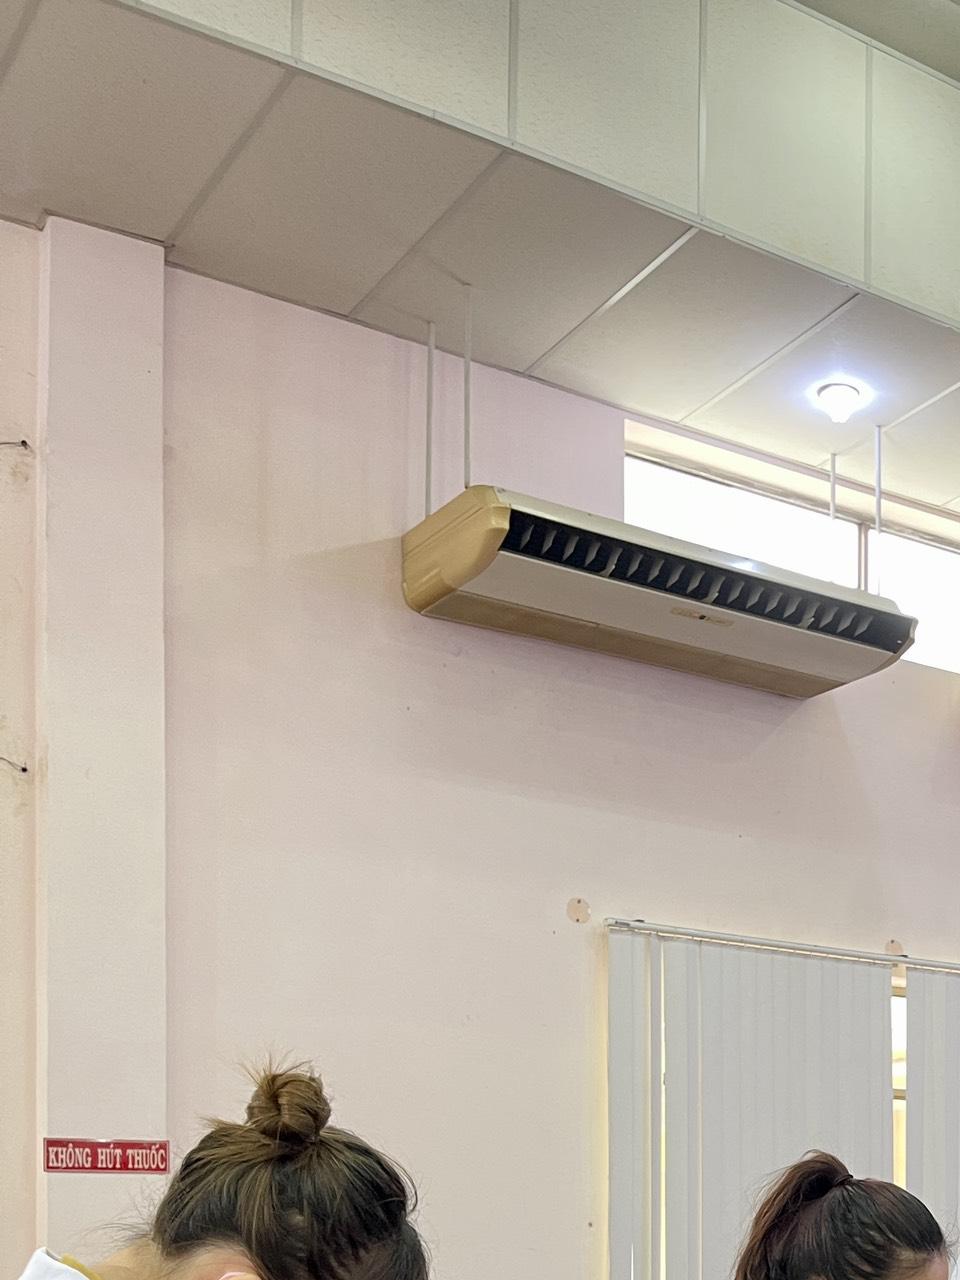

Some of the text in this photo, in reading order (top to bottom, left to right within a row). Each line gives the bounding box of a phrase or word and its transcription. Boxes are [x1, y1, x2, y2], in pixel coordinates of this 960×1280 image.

[48, 1143, 166, 1169] KHÔNG HÚT THUỐC
